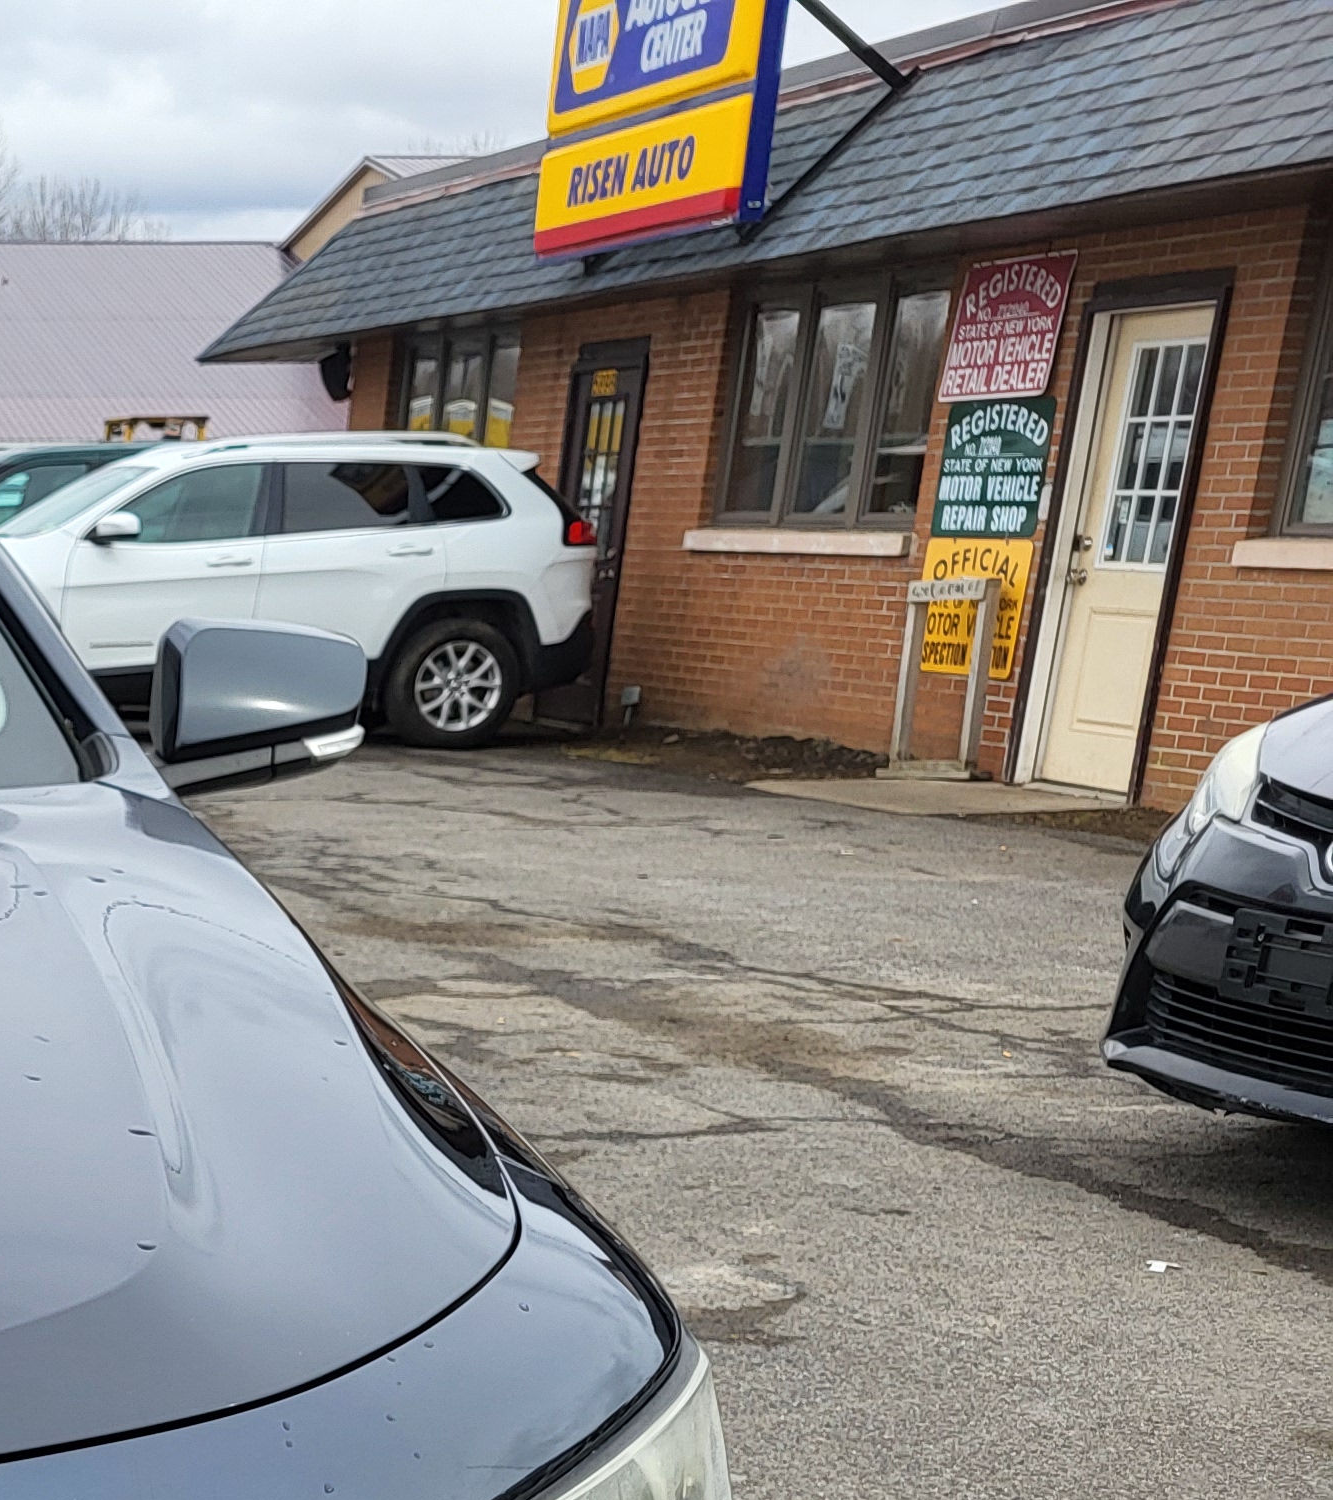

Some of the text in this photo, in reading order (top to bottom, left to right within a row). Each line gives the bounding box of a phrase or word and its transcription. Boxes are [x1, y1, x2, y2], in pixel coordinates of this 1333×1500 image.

[640, 9, 707, 73] CENTER
[567, 135, 696, 208] RISEN AUTO
[966, 264, 1061, 319] REGISTERED
[958, 315, 1055, 340] STATE OF NEW YORK
[950, 333, 1053, 367] MOTOR VEHICLE
[943, 362, 1048, 395] RETAIL DEALER
[950, 404, 1048, 450] REGISTERED
[943, 457, 1044, 473] STATE OF NEW YORK
[939, 475, 1040, 502] MOTOR VEHICLE
[941, 505, 1027, 532] REPAIR SHOP
[933, 546, 1019, 588] OFFICIAL
[927, 612, 961, 637] OTOR
[921, 641, 968, 666] SPECTION
